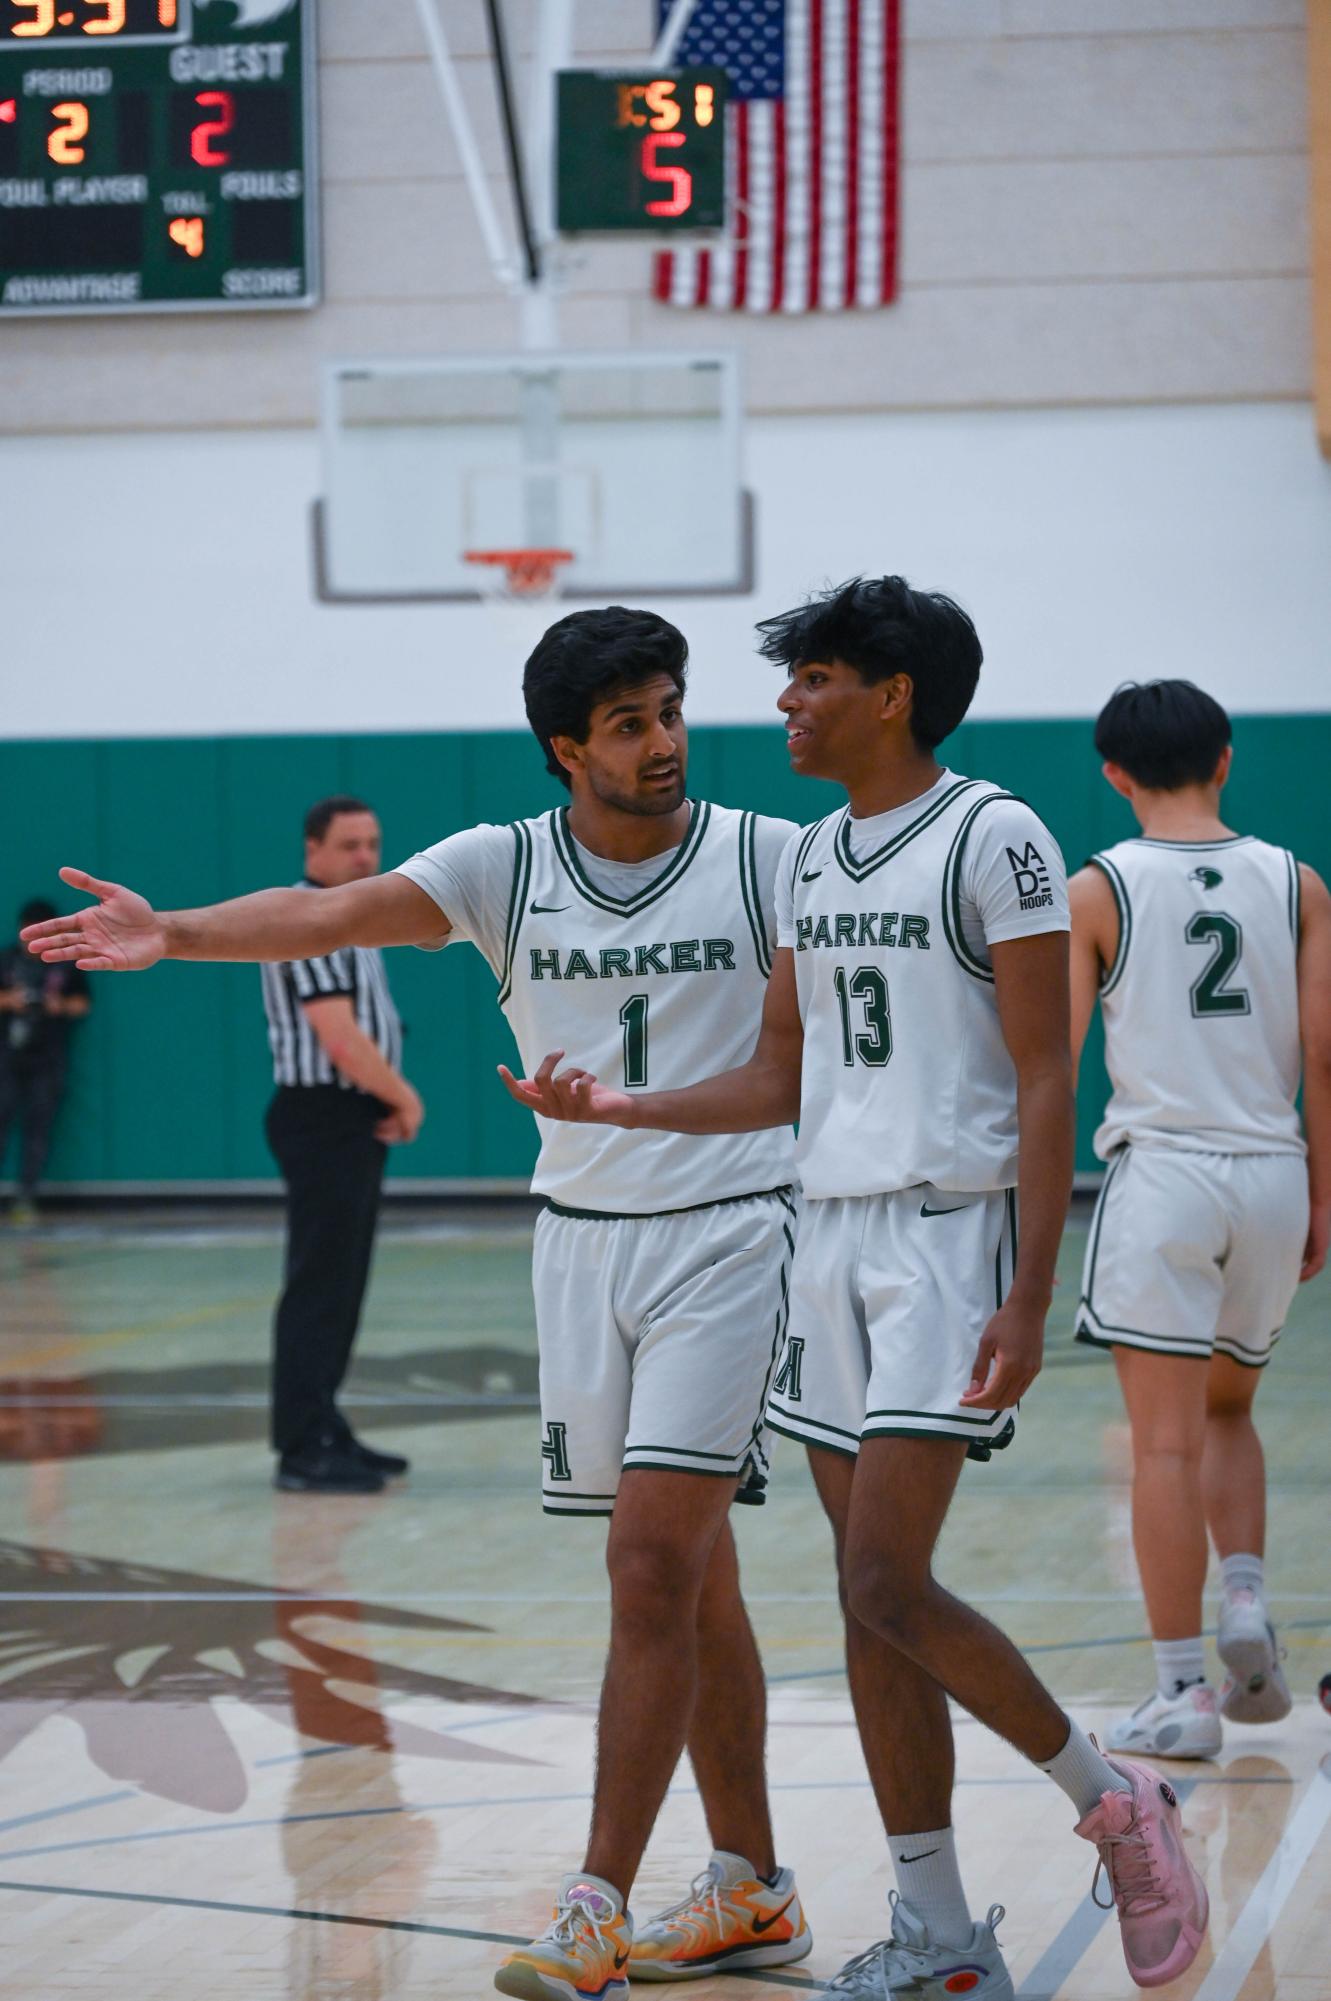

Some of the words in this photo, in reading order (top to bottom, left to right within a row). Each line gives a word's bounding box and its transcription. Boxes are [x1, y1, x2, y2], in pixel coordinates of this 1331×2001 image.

[23, 67, 113, 96] PERIOD
[169, 42, 288, 83] GUEST
[47, 102, 89, 165] 2
[190, 91, 236, 167] 2
[0, 177, 46, 208] OUL
[52, 174, 148, 206] PLAYER
[220, 170, 301, 200] FOULS
[641, 132, 692, 217] 5
[169, 217, 204, 258] 4
[4, 272, 141, 302] ADVANTAGE
[222, 267, 301, 298] SCORE
[1020, 893, 1054, 911] HOOPS
[796, 912, 930, 951] HARKER
[530, 938, 736, 980] HARKER
[1184, 911, 1252, 1019] 2
[833, 966, 893, 1068] 13
[619, 994, 649, 1088] 1
